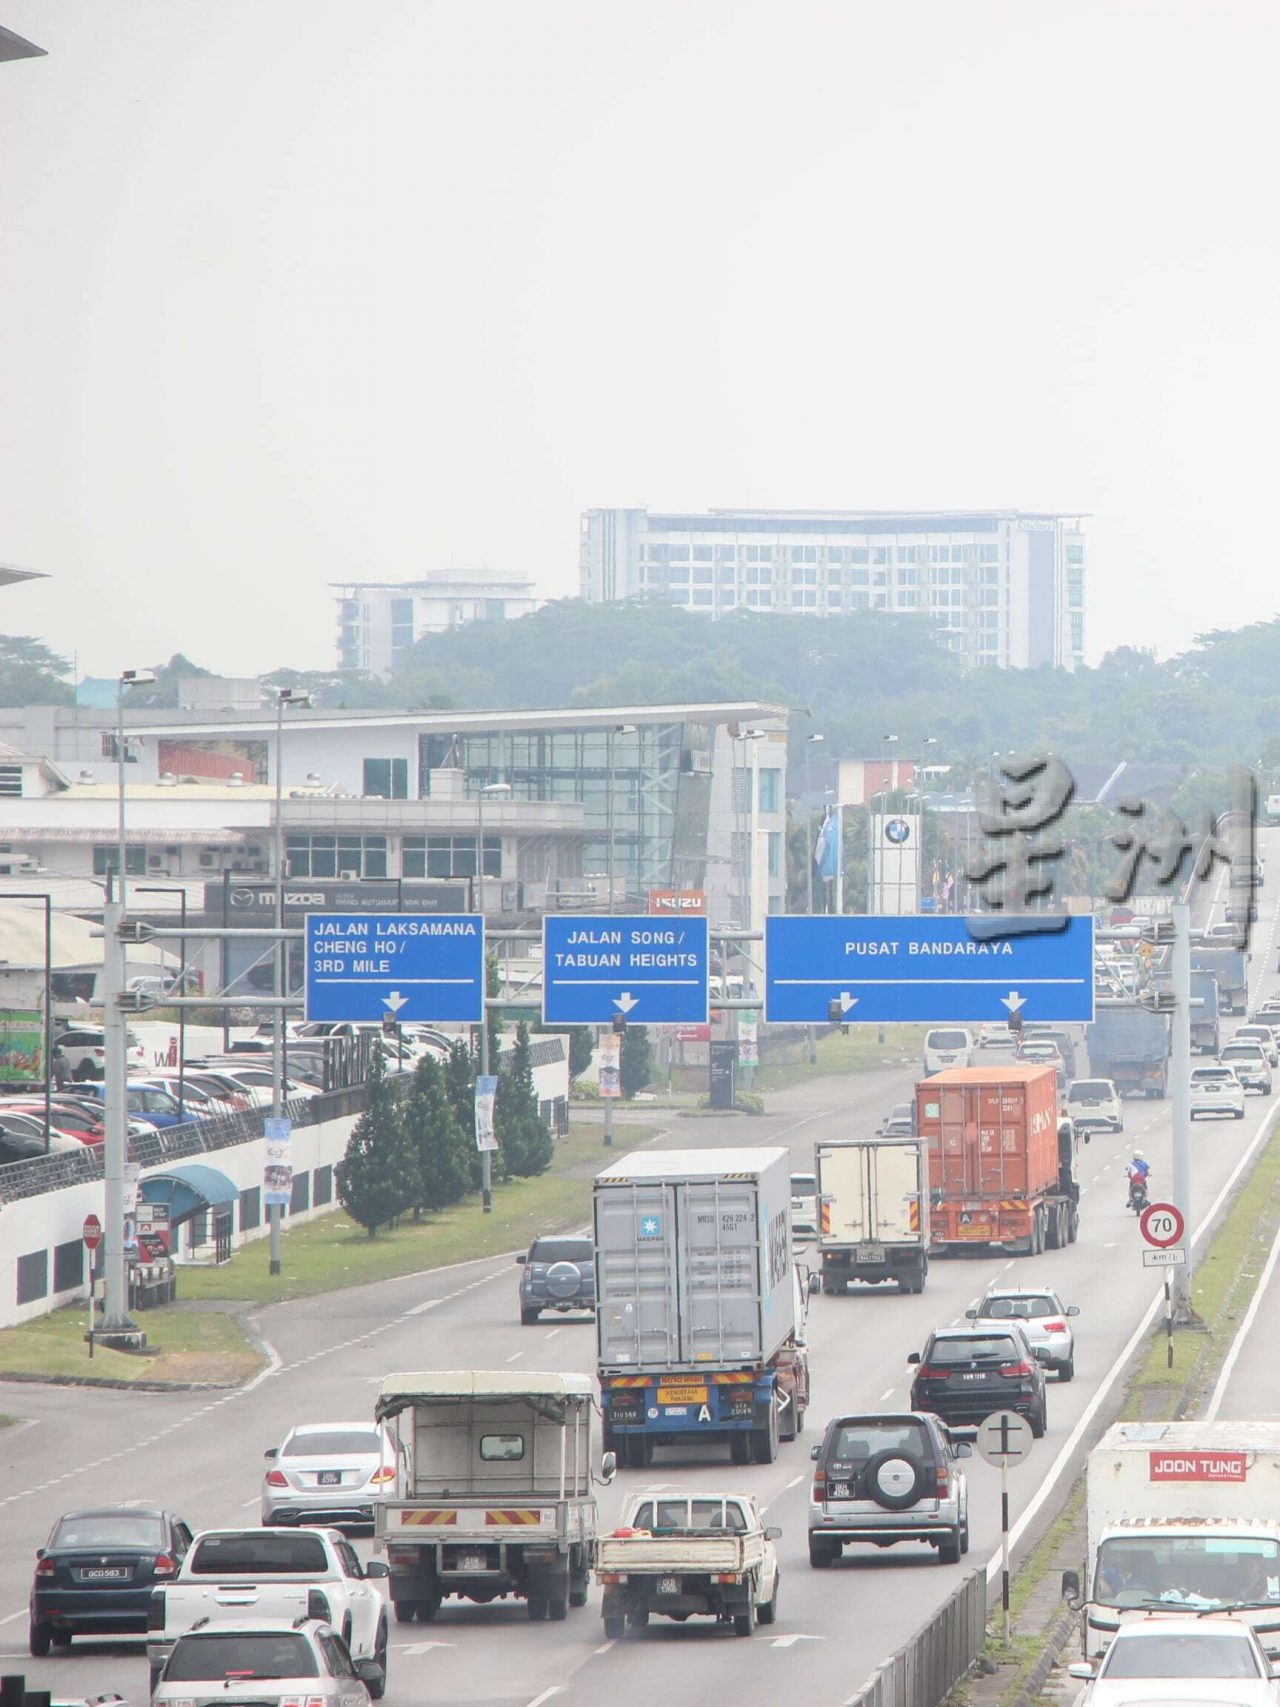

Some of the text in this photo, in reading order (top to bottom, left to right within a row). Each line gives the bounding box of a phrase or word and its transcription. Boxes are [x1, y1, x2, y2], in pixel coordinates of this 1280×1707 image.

[258, 892, 326, 905] mzda
[314, 922, 476, 936] JALAN LAKSAMANA
[567, 931, 621, 944] JALAN
[314, 941, 367, 954] CHENG
[845, 942, 1013, 955] PUSAT BANDARAYA
[314, 960, 390, 973] 3RD MILE
[555, 953, 697, 967] TABUAN HEIGHTS
[697, 1215, 715, 1224] MRSU
[735, 1214, 748, 1223] 224
[1151, 1217, 1172, 1233] 70
[721, 1223, 738, 1232] 45G1
[698, 1404, 711, 1421] A
[1154, 1459, 1241, 1474] JOON TUNG
